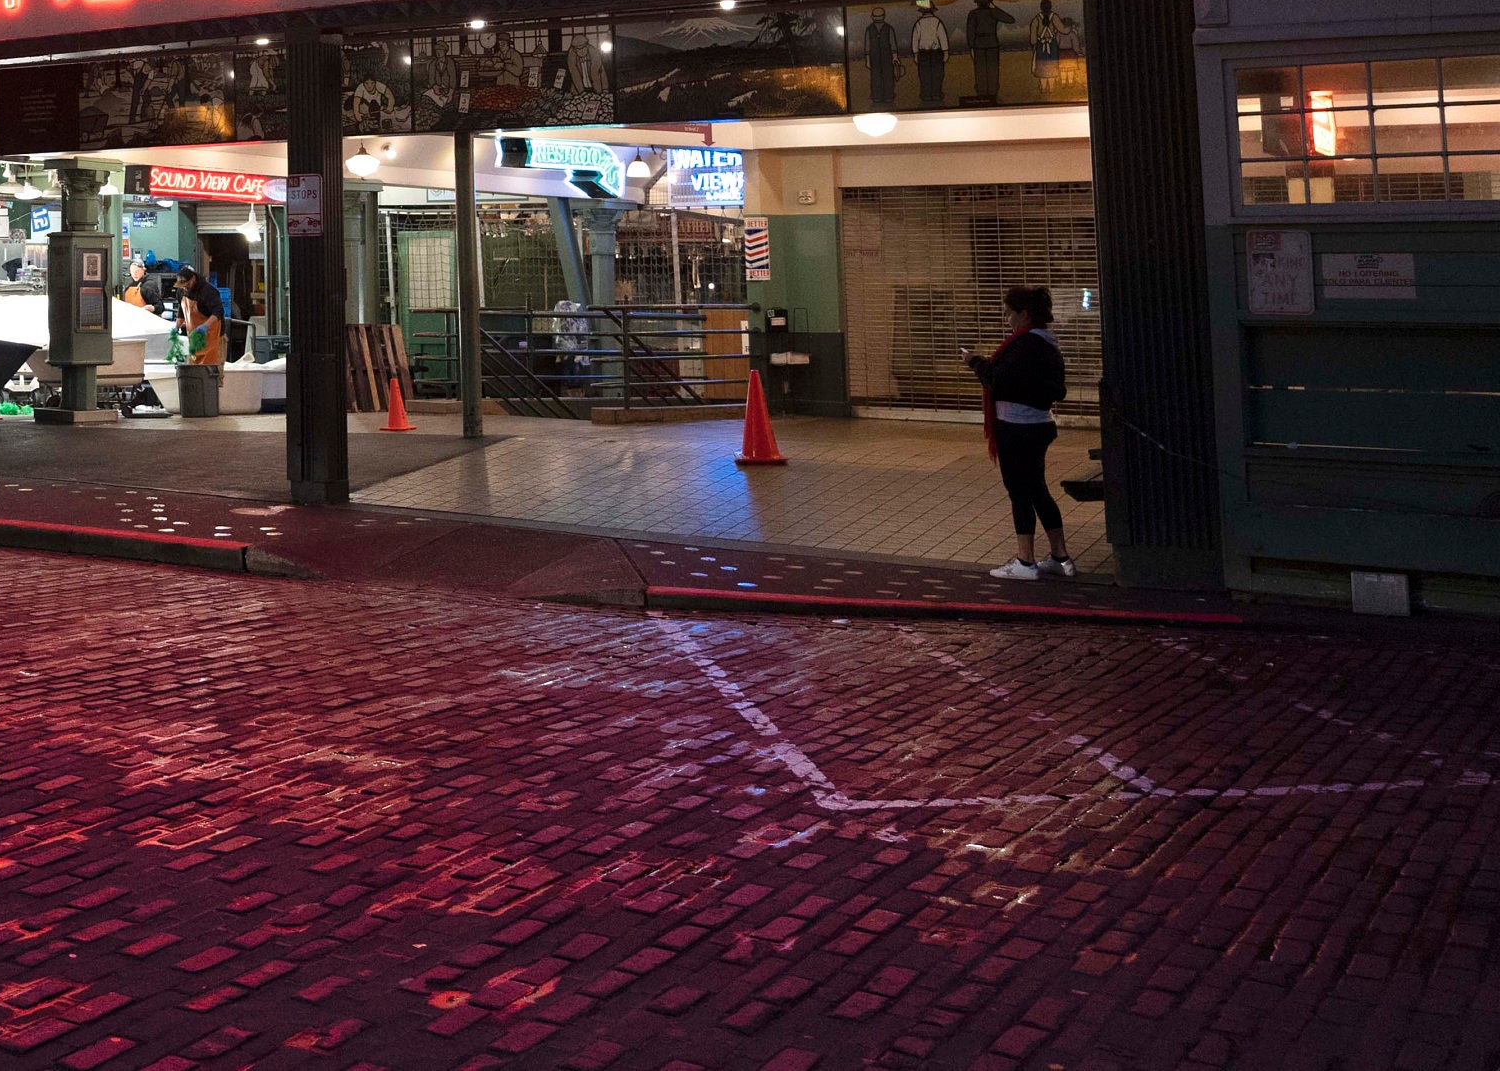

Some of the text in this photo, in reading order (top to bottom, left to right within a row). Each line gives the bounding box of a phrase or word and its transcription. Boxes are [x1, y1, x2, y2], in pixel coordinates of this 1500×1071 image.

[150, 169, 196, 188] SOUND
[200, 172, 231, 192] VIEW
[233, 175, 265, 194] CAFE
[291, 189, 318, 199] STOPS
[31, 208, 49, 230] 12
